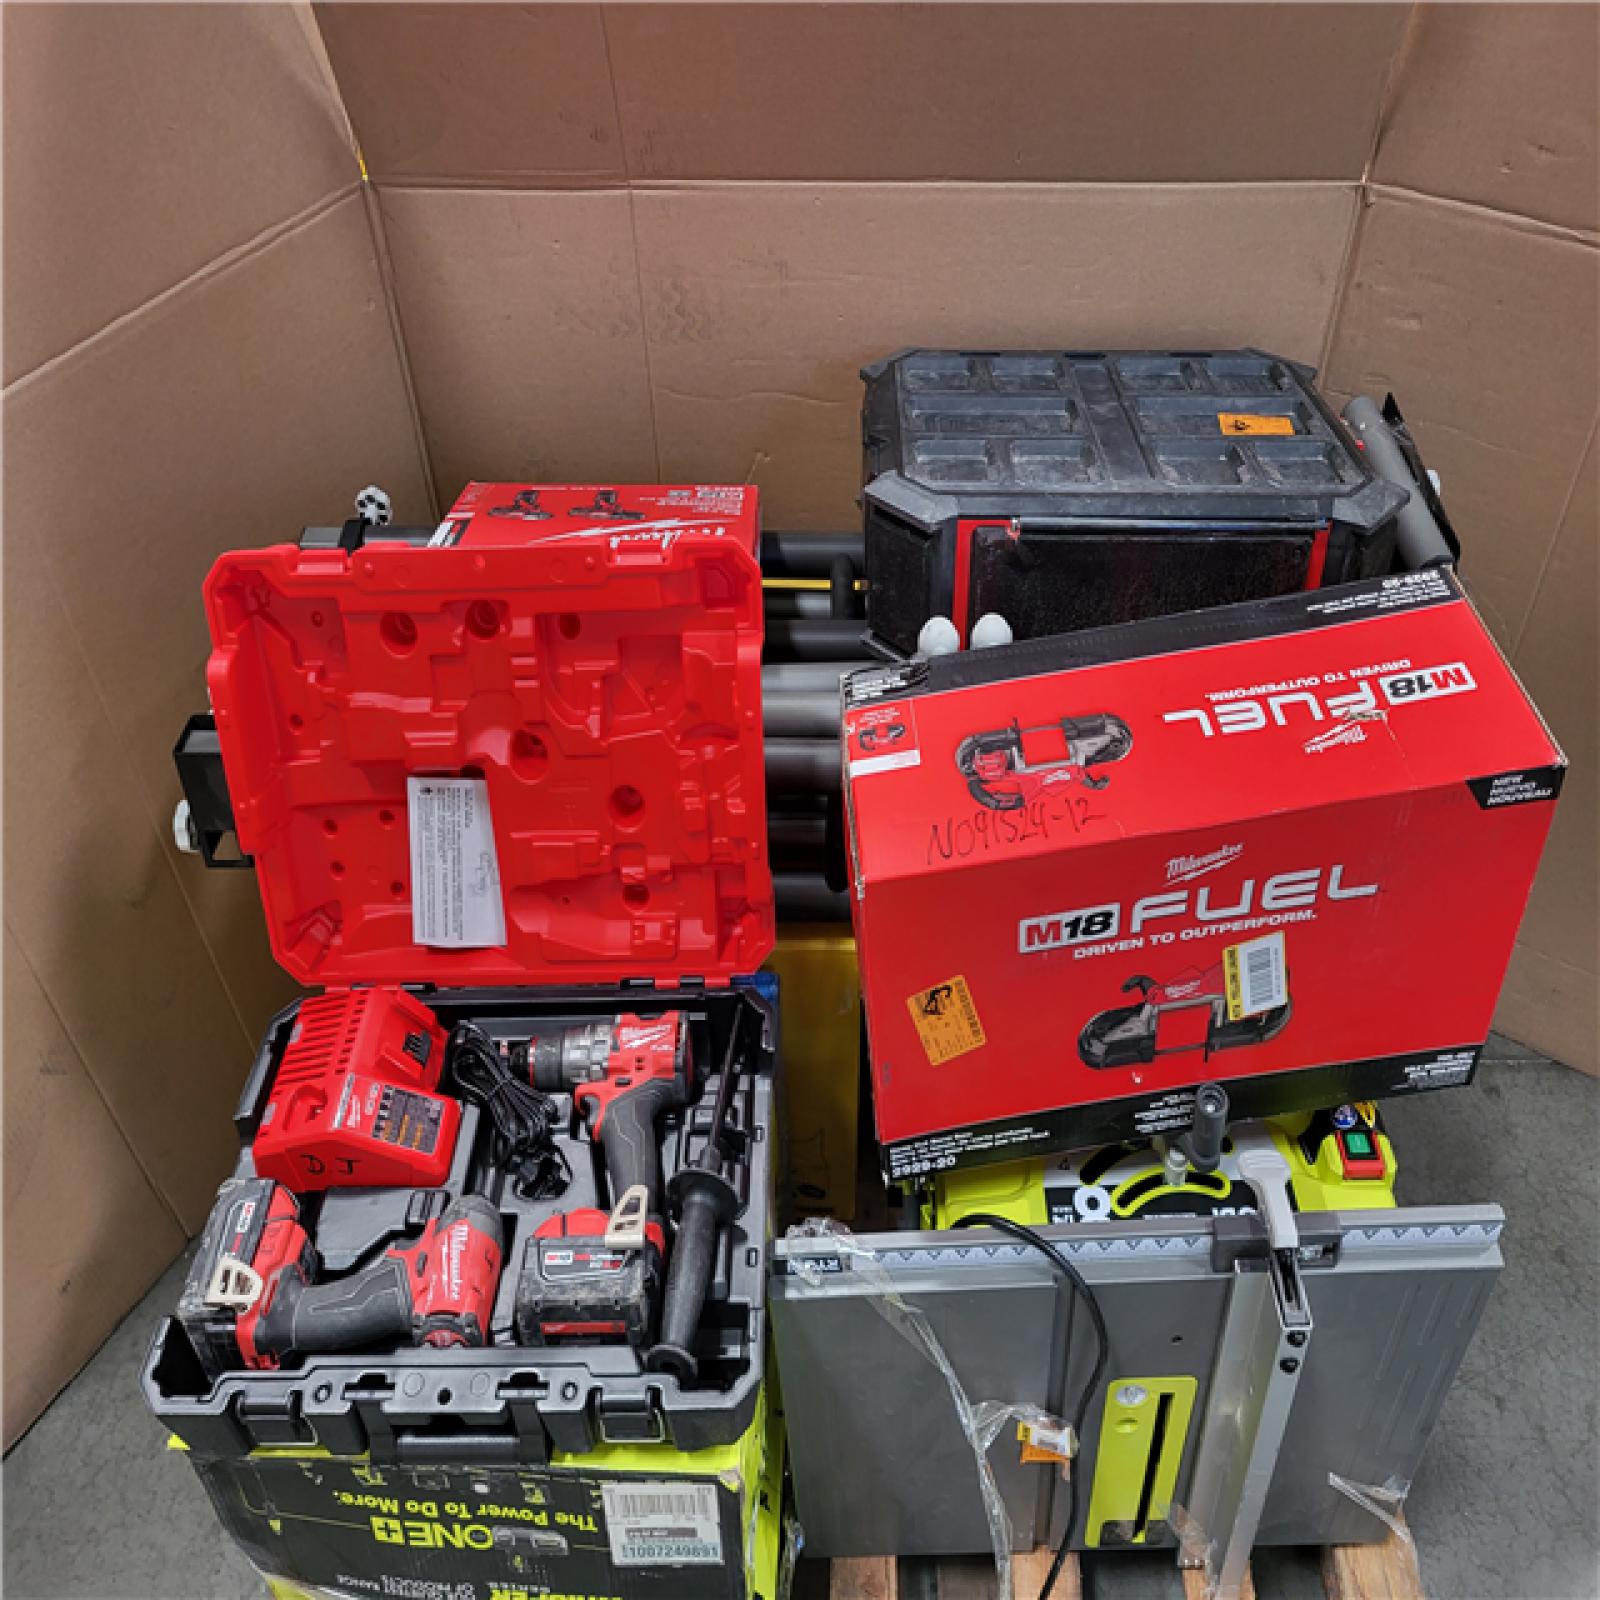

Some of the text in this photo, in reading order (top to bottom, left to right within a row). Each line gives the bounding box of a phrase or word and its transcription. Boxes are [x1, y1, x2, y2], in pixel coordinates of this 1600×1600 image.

[1324, 671, 1348, 684] TO
[1349, 660, 1411, 679] DRIVEN
[1163, 666, 1469, 737] M18 FUEL
[1164, 844, 1243, 880] Milwaukee
[1024, 864, 1378, 949] M18 FUEL
[1073, 936, 1144, 959] DRIVEN
[1149, 931, 1176, 945] TO
[405, 1501, 439, 1518] Do
[444, 1502, 473, 1520] To
[477, 1503, 548, 1526] Power
[554, 1511, 598, 1532] The
